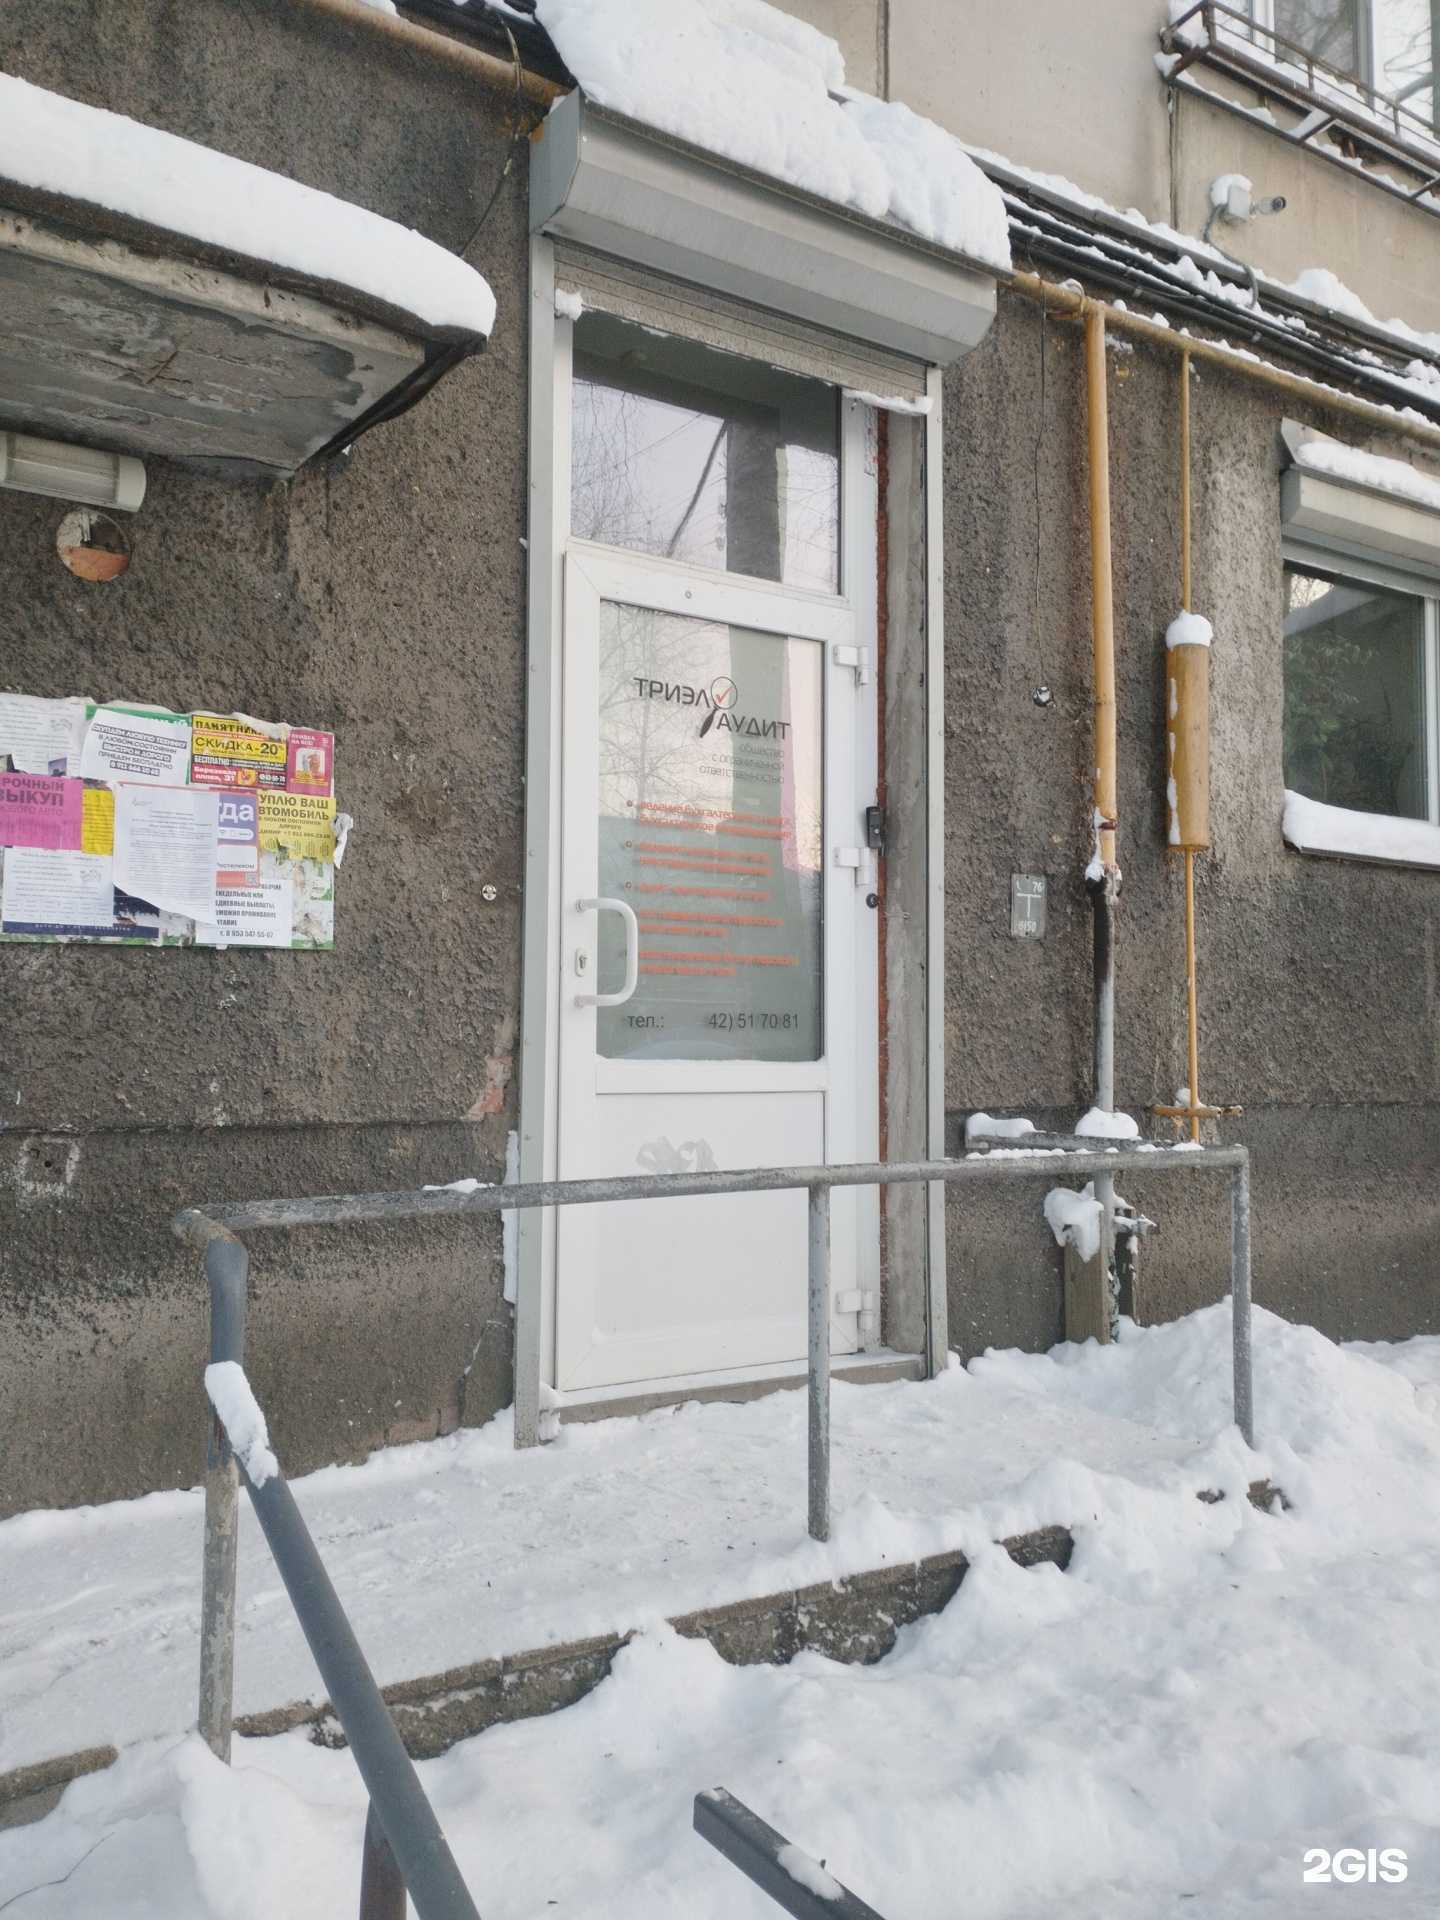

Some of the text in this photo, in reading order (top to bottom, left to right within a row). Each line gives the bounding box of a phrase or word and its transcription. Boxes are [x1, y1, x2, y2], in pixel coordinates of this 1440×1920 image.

[633, 677, 711, 709] ТРИЭЛ
[195, 720, 262, 735] ПАМЯТНИ
[716, 712, 791, 740] АУДИТ
[2, 778, 65, 792] РОЧНЫЙ
[259, 794, 329, 809] УПЛЮ ВАШ
[258, 806, 330, 821] ВТОМОБИЛЬ
[627, 1013, 799, 1032] тел.: 42) 51 70 81
